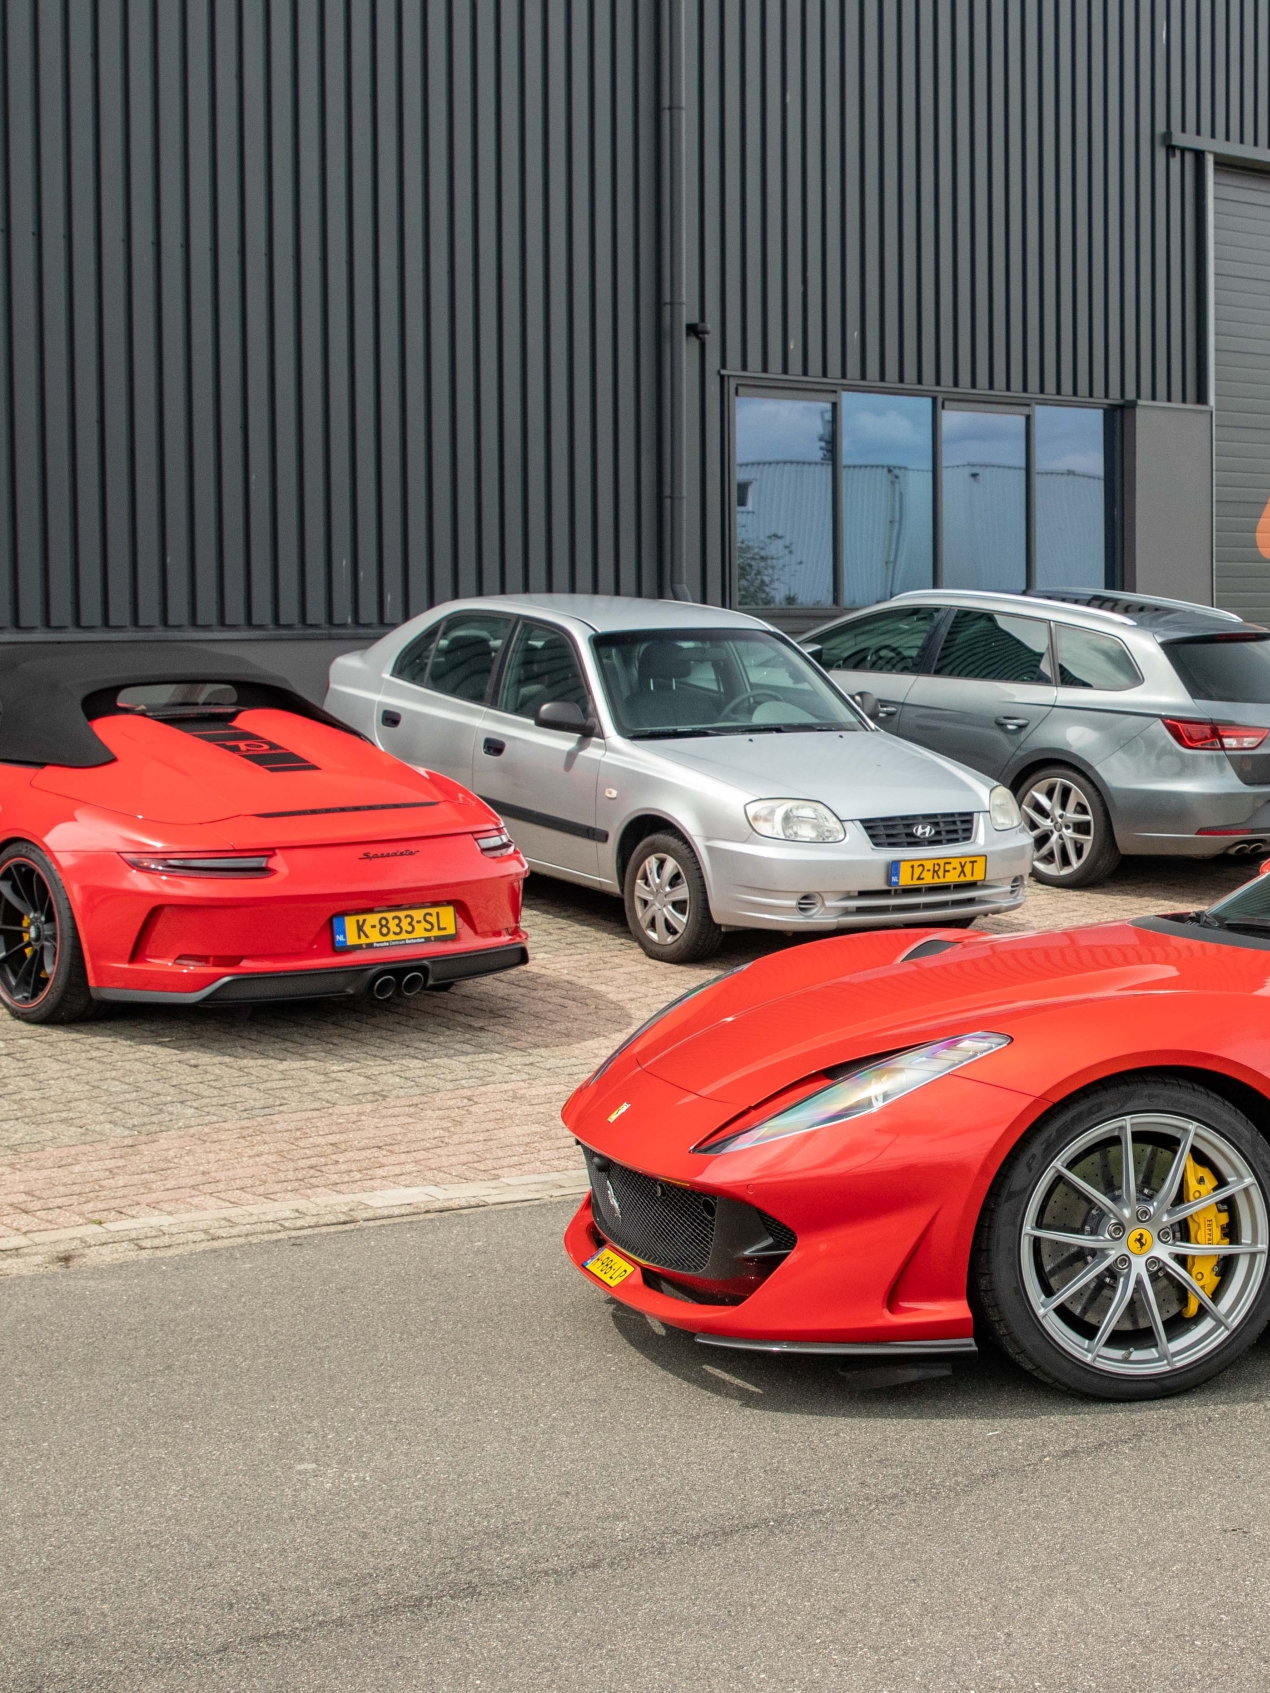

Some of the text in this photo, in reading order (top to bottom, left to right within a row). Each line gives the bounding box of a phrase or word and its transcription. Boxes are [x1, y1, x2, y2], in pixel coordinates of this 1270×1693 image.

[358, 849, 419, 861] Speedster
[909, 860, 978, 881] 12-RF-XT
[356, 911, 448, 940] K-833-SL
[336, 934, 346, 942] NL
